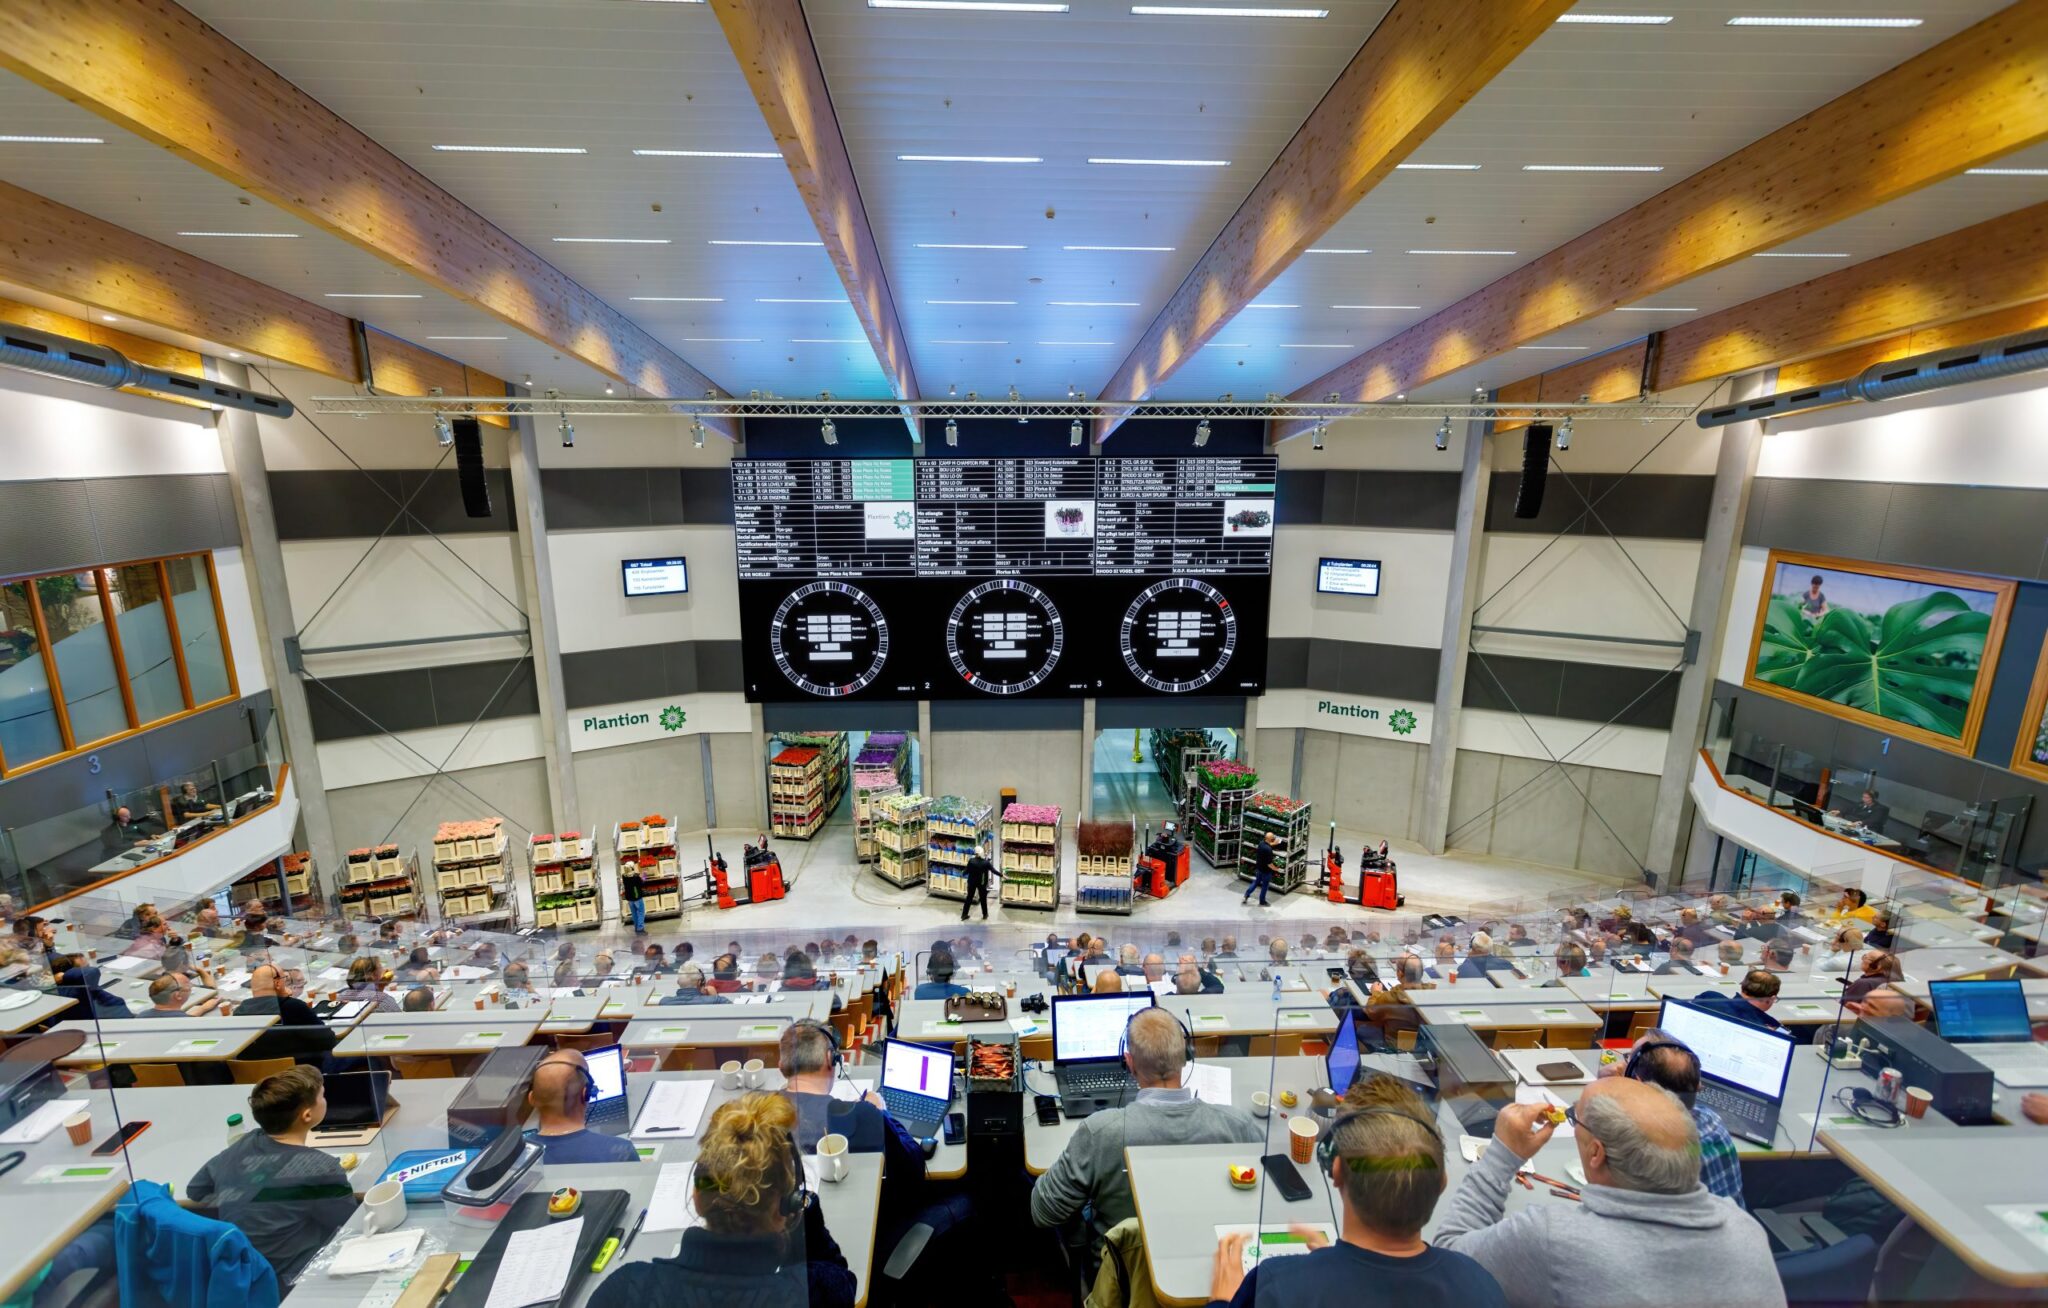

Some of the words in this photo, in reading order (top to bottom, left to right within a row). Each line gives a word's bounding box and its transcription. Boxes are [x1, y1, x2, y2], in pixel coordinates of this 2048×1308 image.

[752, 684, 757, 692] 1
[1096, 680, 1102, 688] 3
[1318, 701, 1380, 720] Plantion
[583, 712, 650, 732] Plantion
[1880, 737, 1891, 755] 1
[88, 755, 102, 775] 3
[410, 1152, 464, 1176] NIFTRIK
